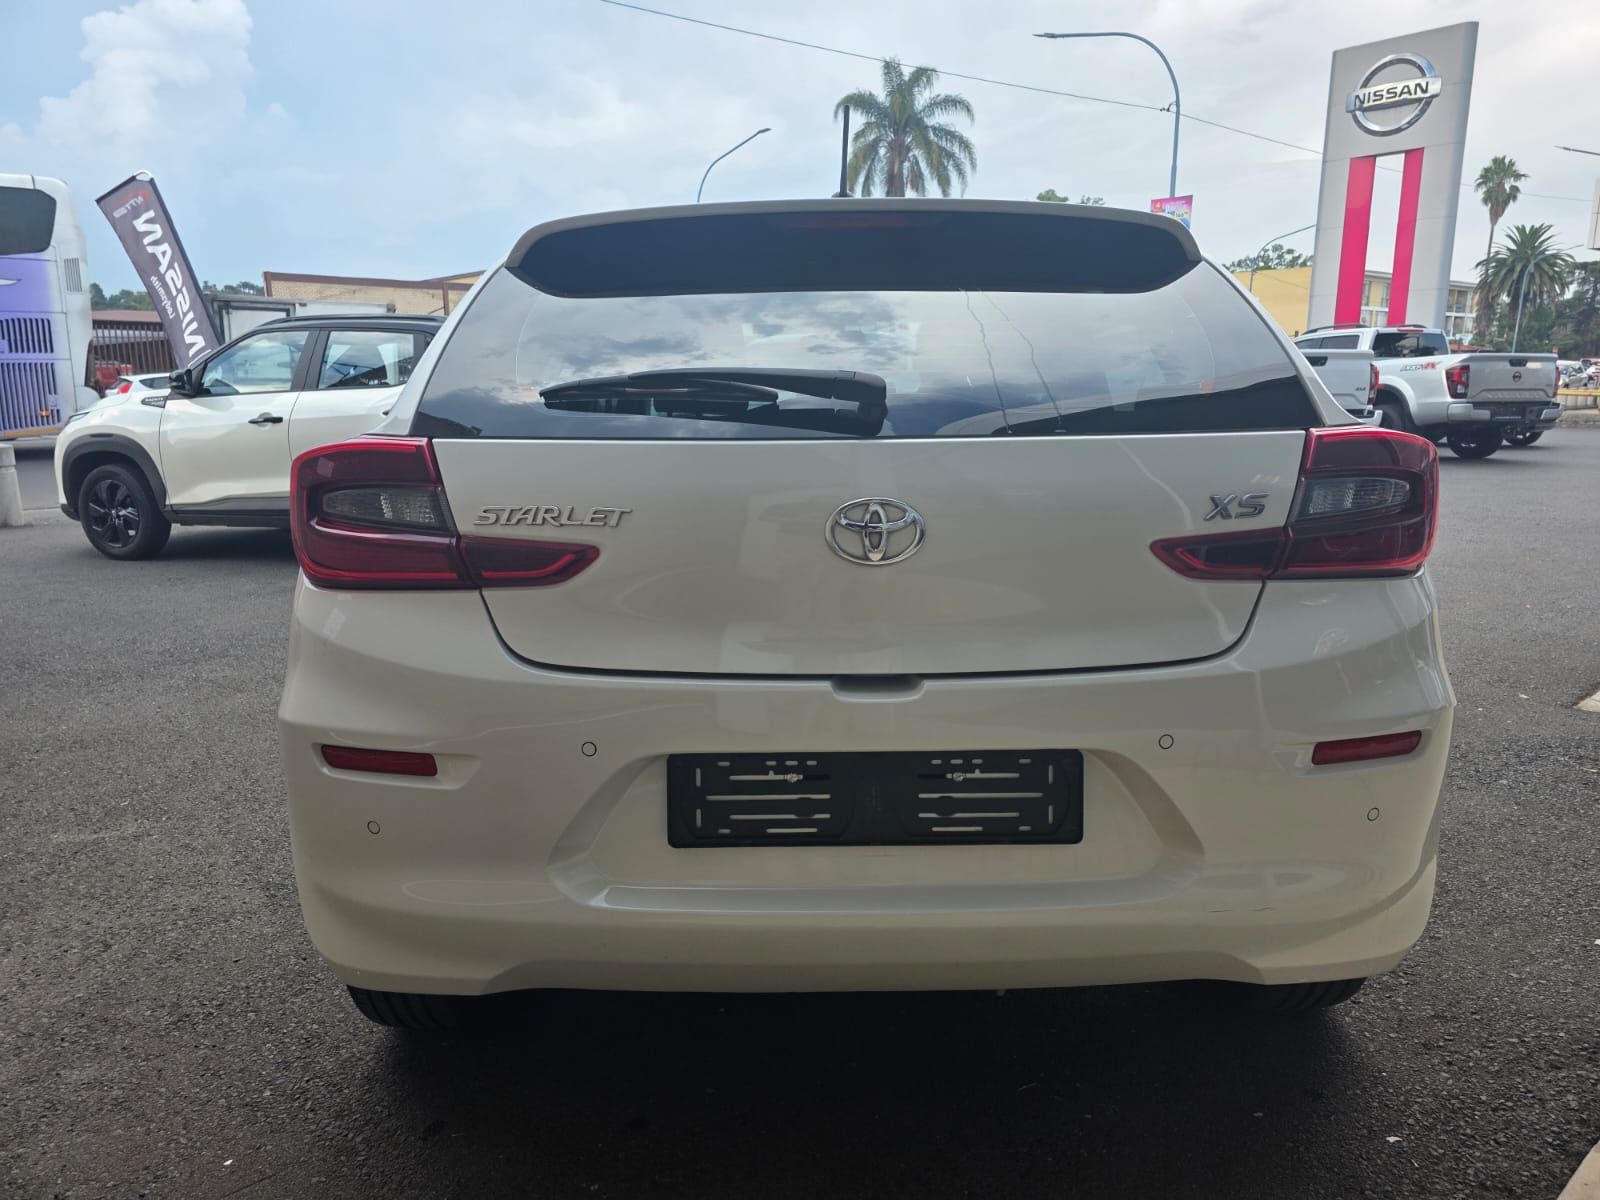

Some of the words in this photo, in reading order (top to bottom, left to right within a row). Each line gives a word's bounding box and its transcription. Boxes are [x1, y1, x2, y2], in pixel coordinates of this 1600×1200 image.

[1354, 80, 1430, 107] NISSAN
[473, 505, 632, 528] STARLET
[1203, 492, 1270, 521] XS
